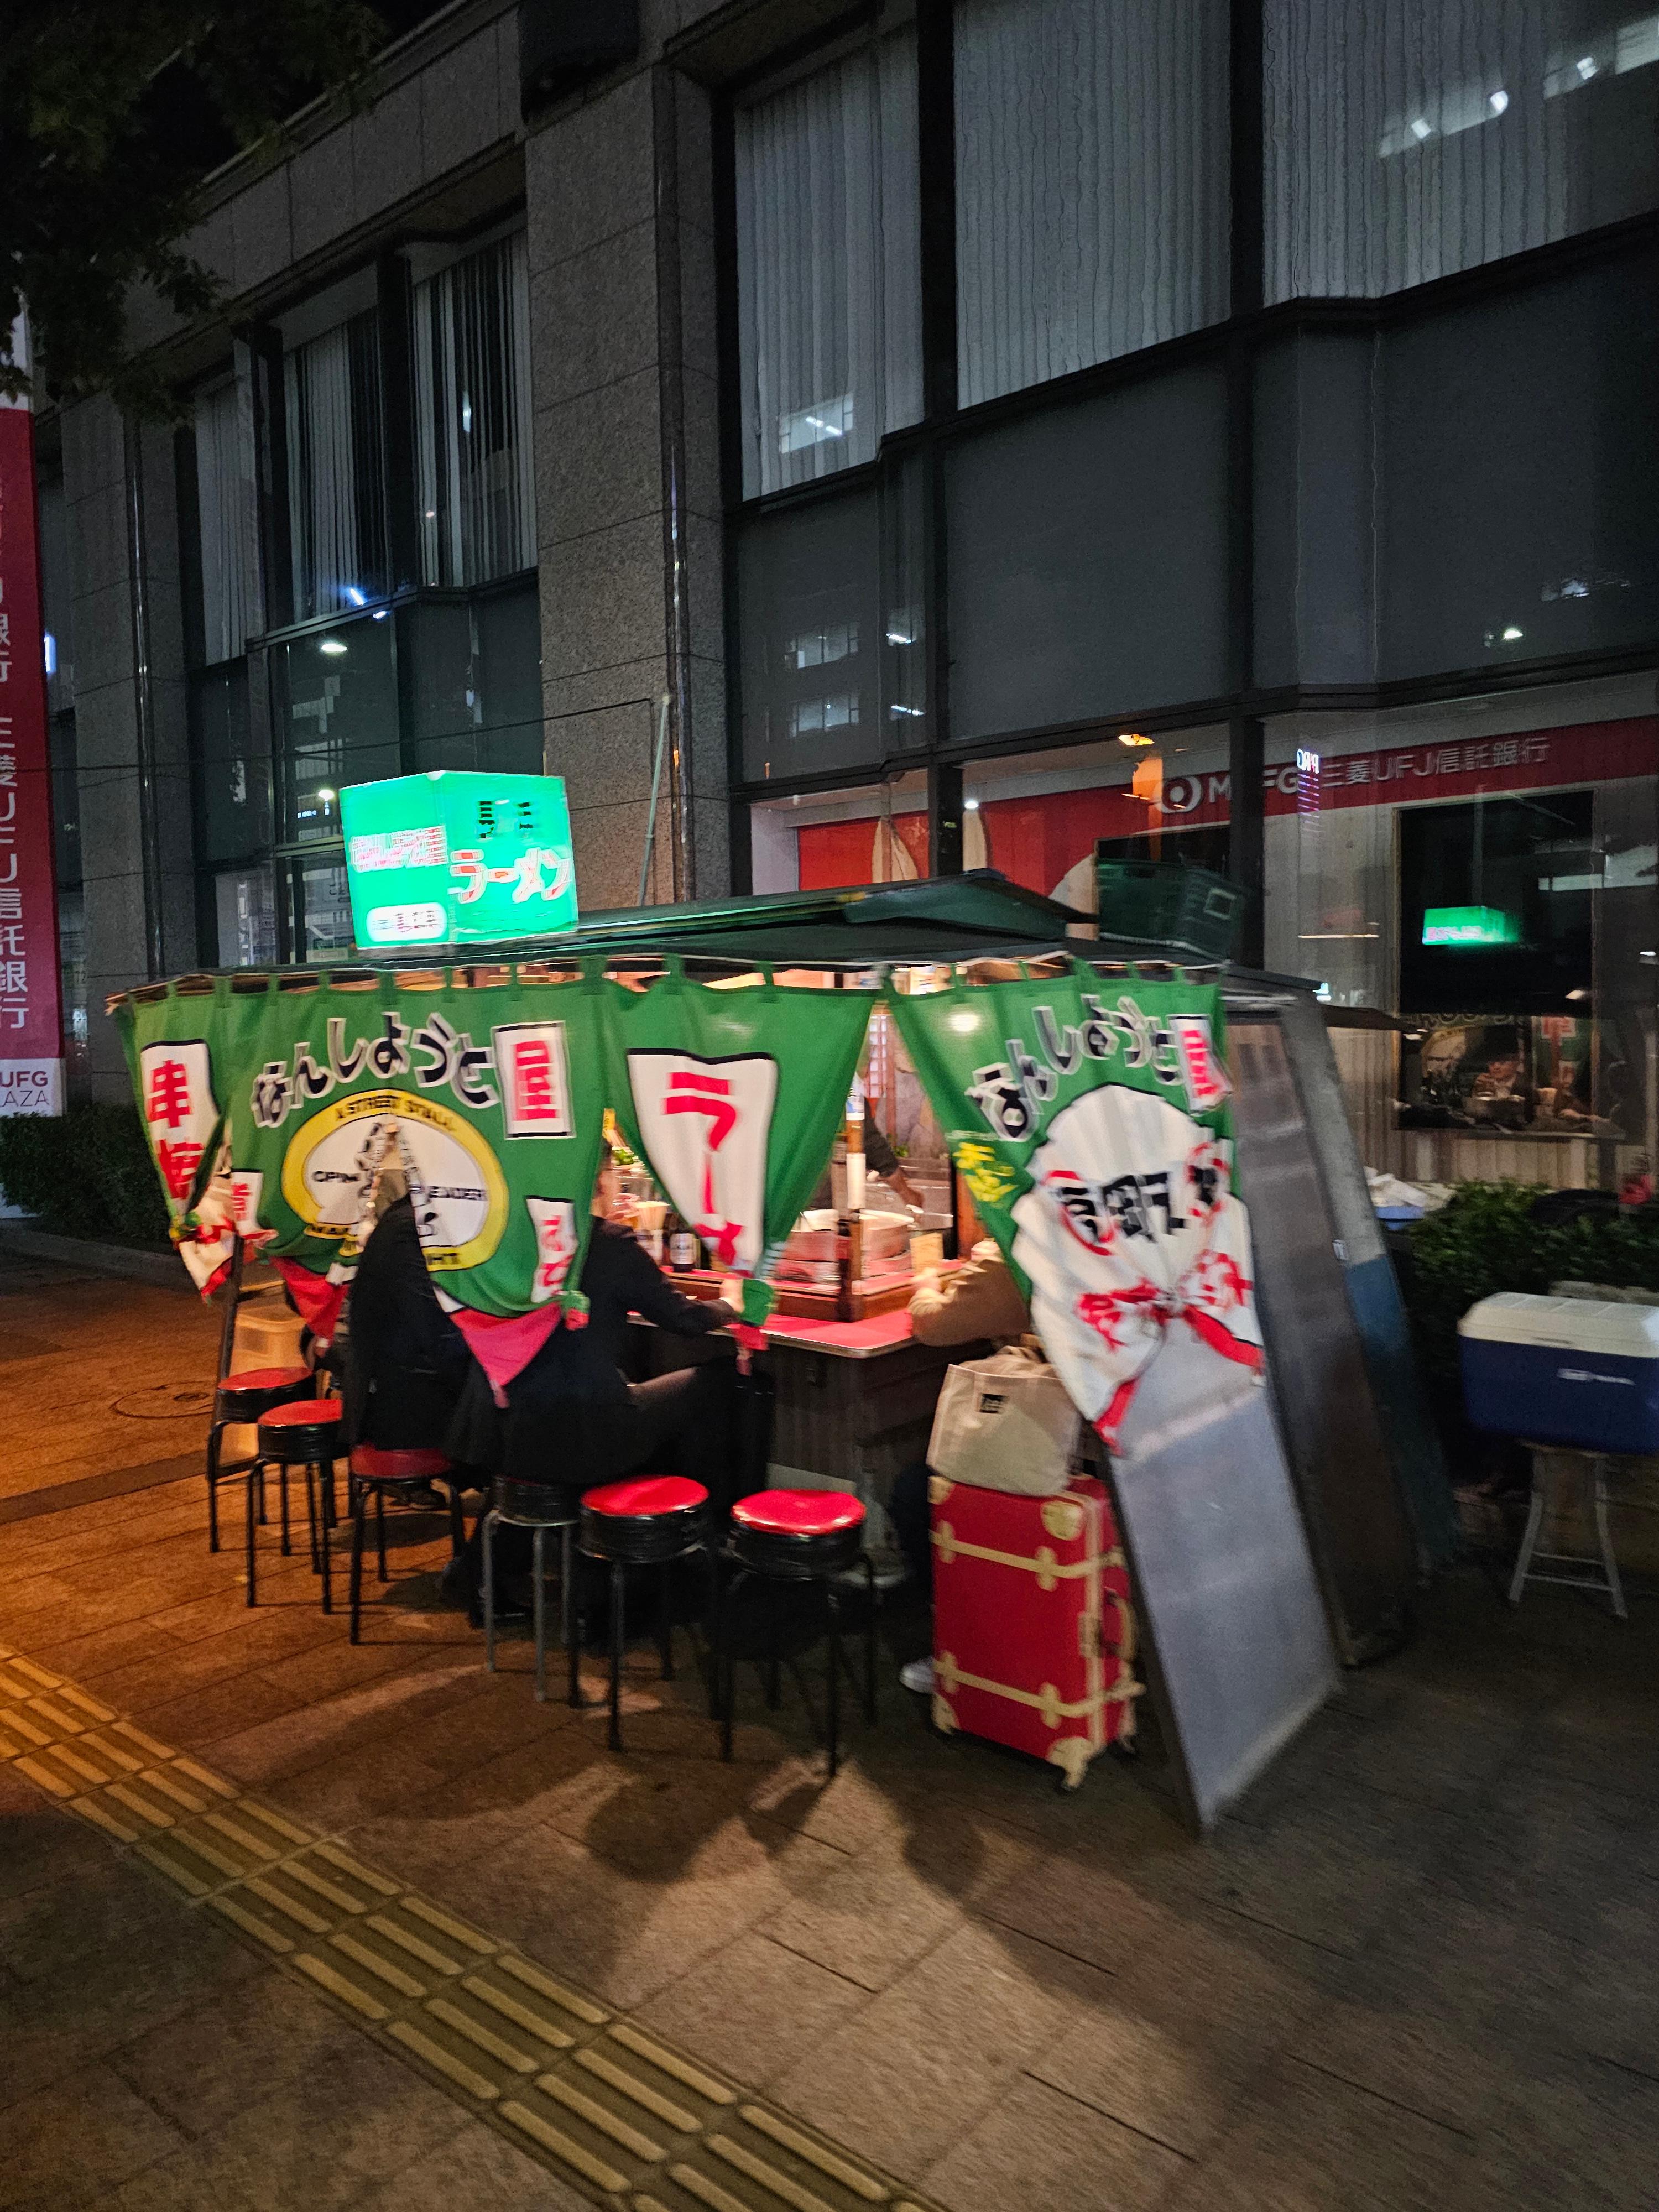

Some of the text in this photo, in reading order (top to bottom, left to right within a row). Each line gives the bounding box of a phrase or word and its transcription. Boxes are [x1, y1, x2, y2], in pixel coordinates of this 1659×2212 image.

[1209, 736, 1550, 803] MFG 三菱UFJ信託銀行
[447, 847, 571, 904] ラーメン
[0, 1071, 48, 1087] UFG
[0, 1090, 49, 1107] AZA
[662, 1072, 742, 1266] ラーメ
